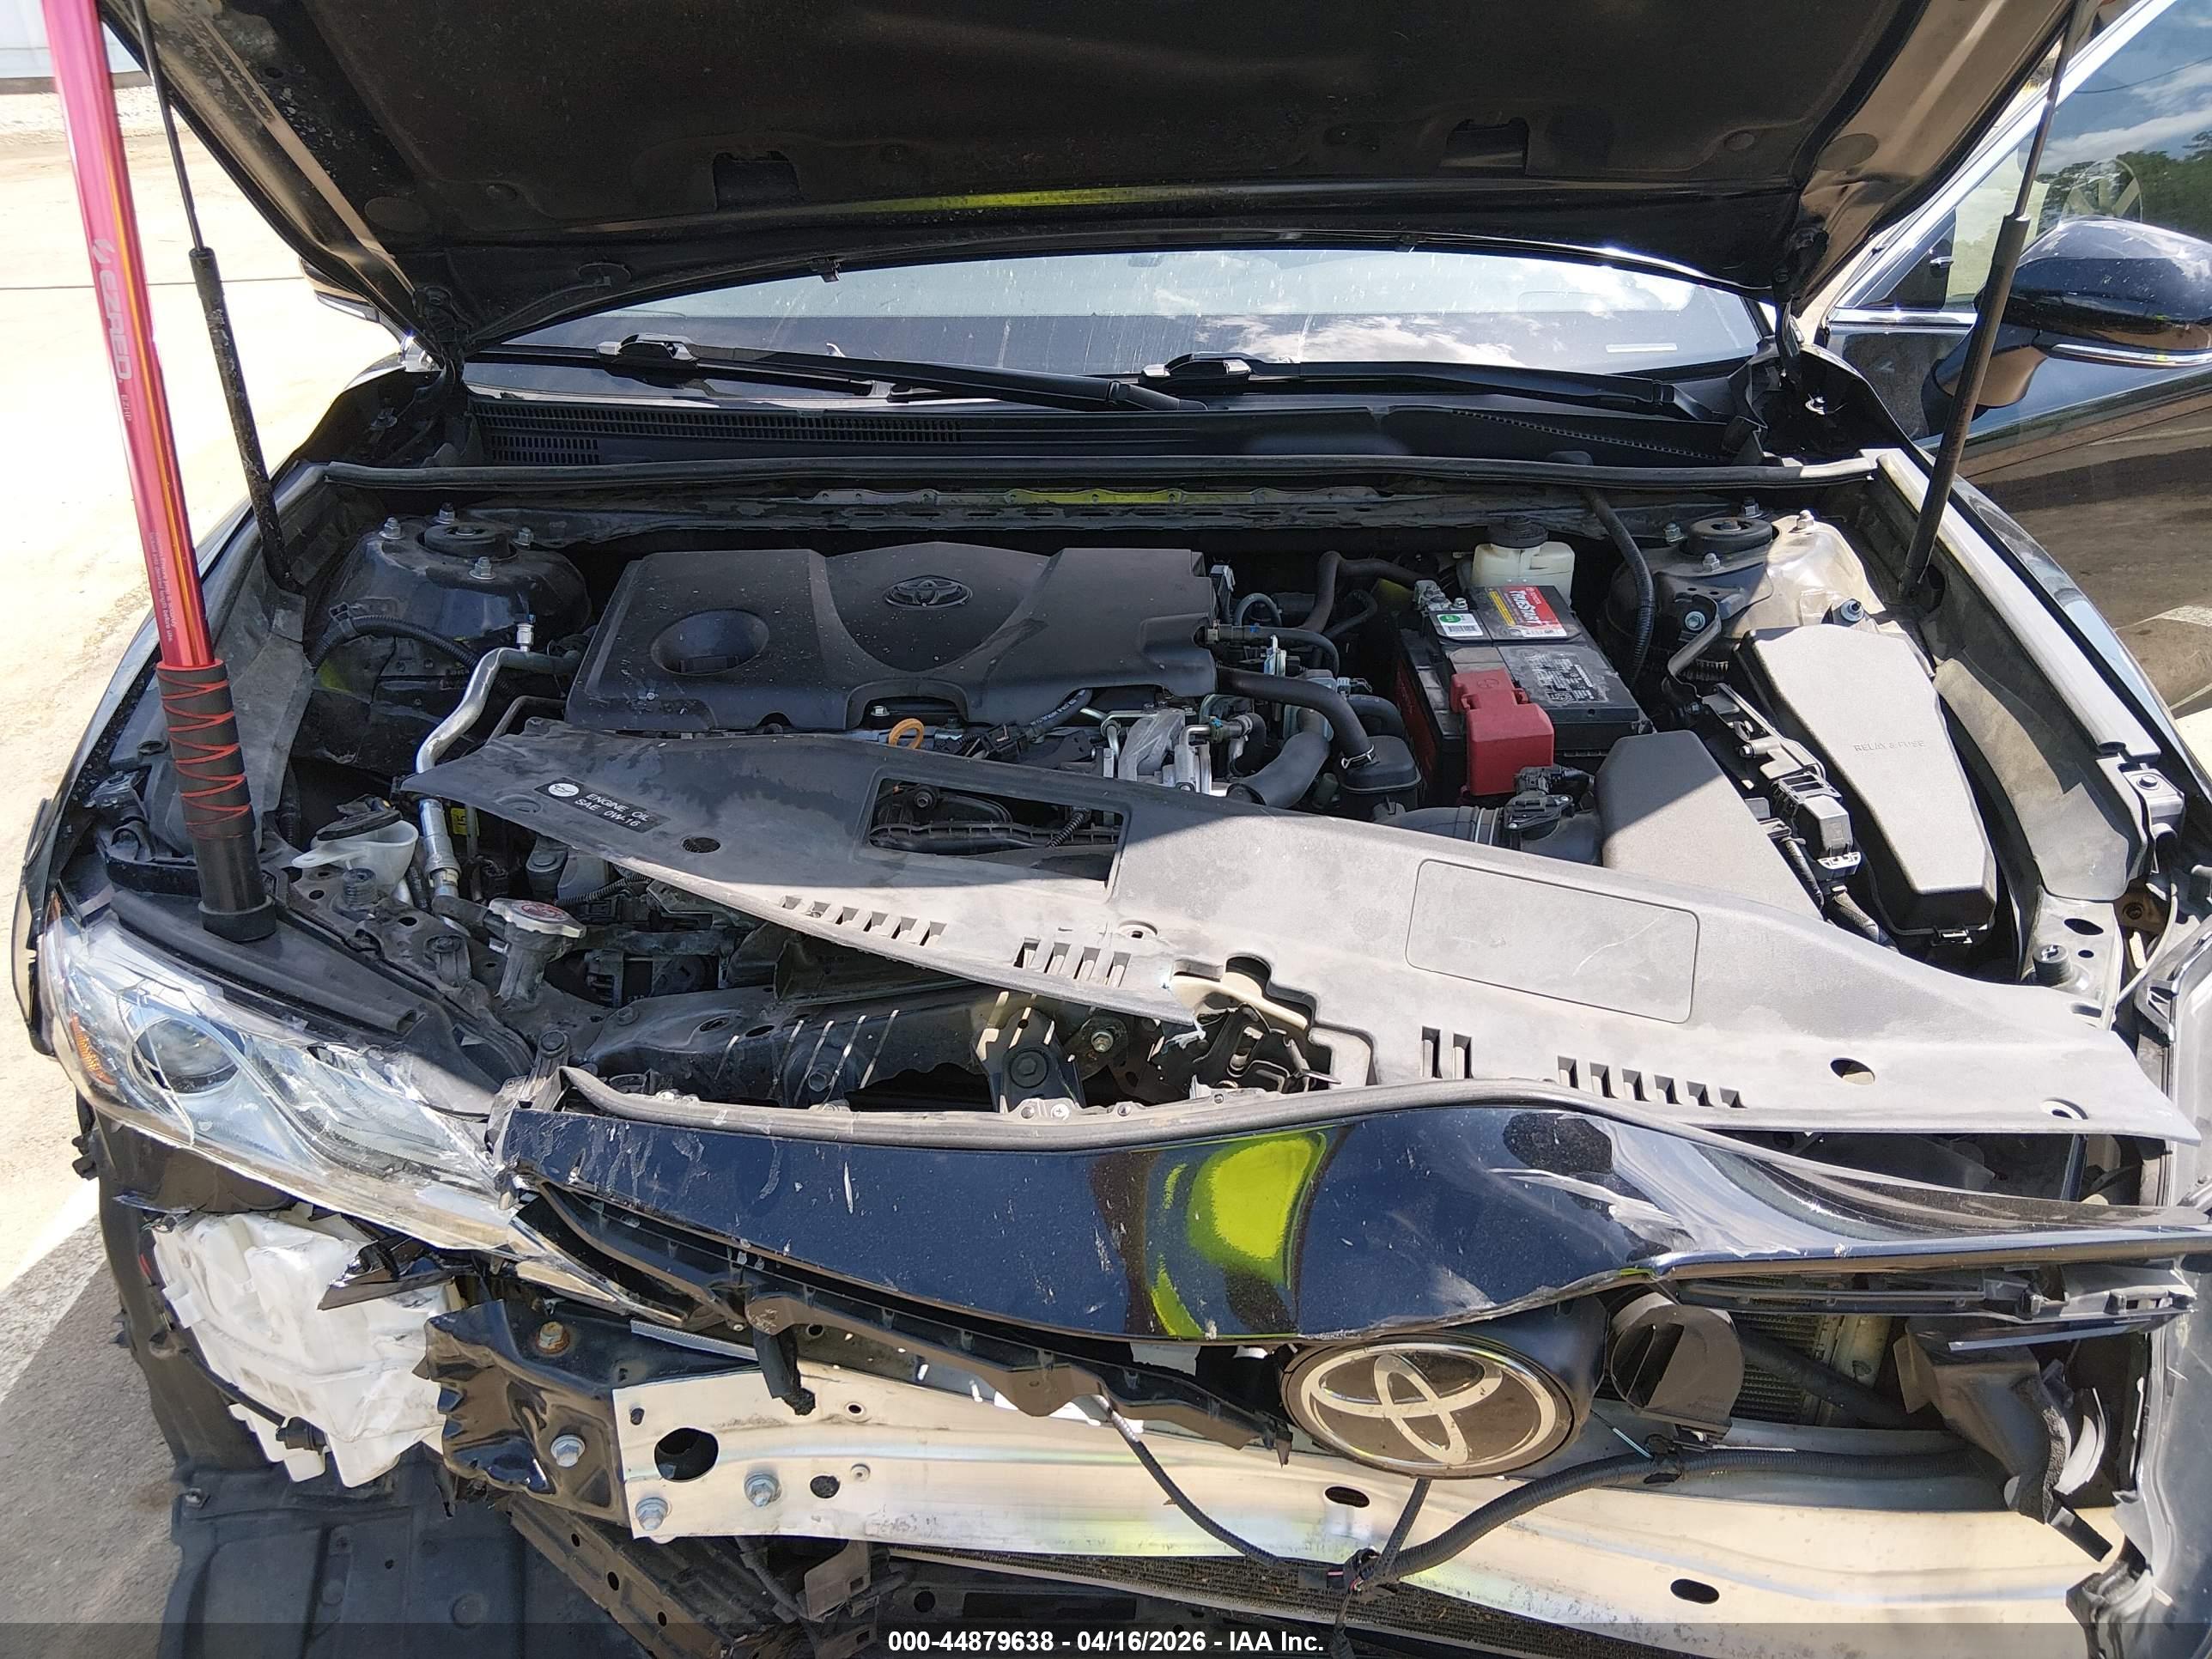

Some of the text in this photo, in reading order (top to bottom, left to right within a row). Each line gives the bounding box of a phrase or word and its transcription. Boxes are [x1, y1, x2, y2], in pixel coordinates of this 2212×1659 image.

[574, 799, 641, 827] SAE 0W-16
[585, 793, 651, 822] ENGINE OIL
